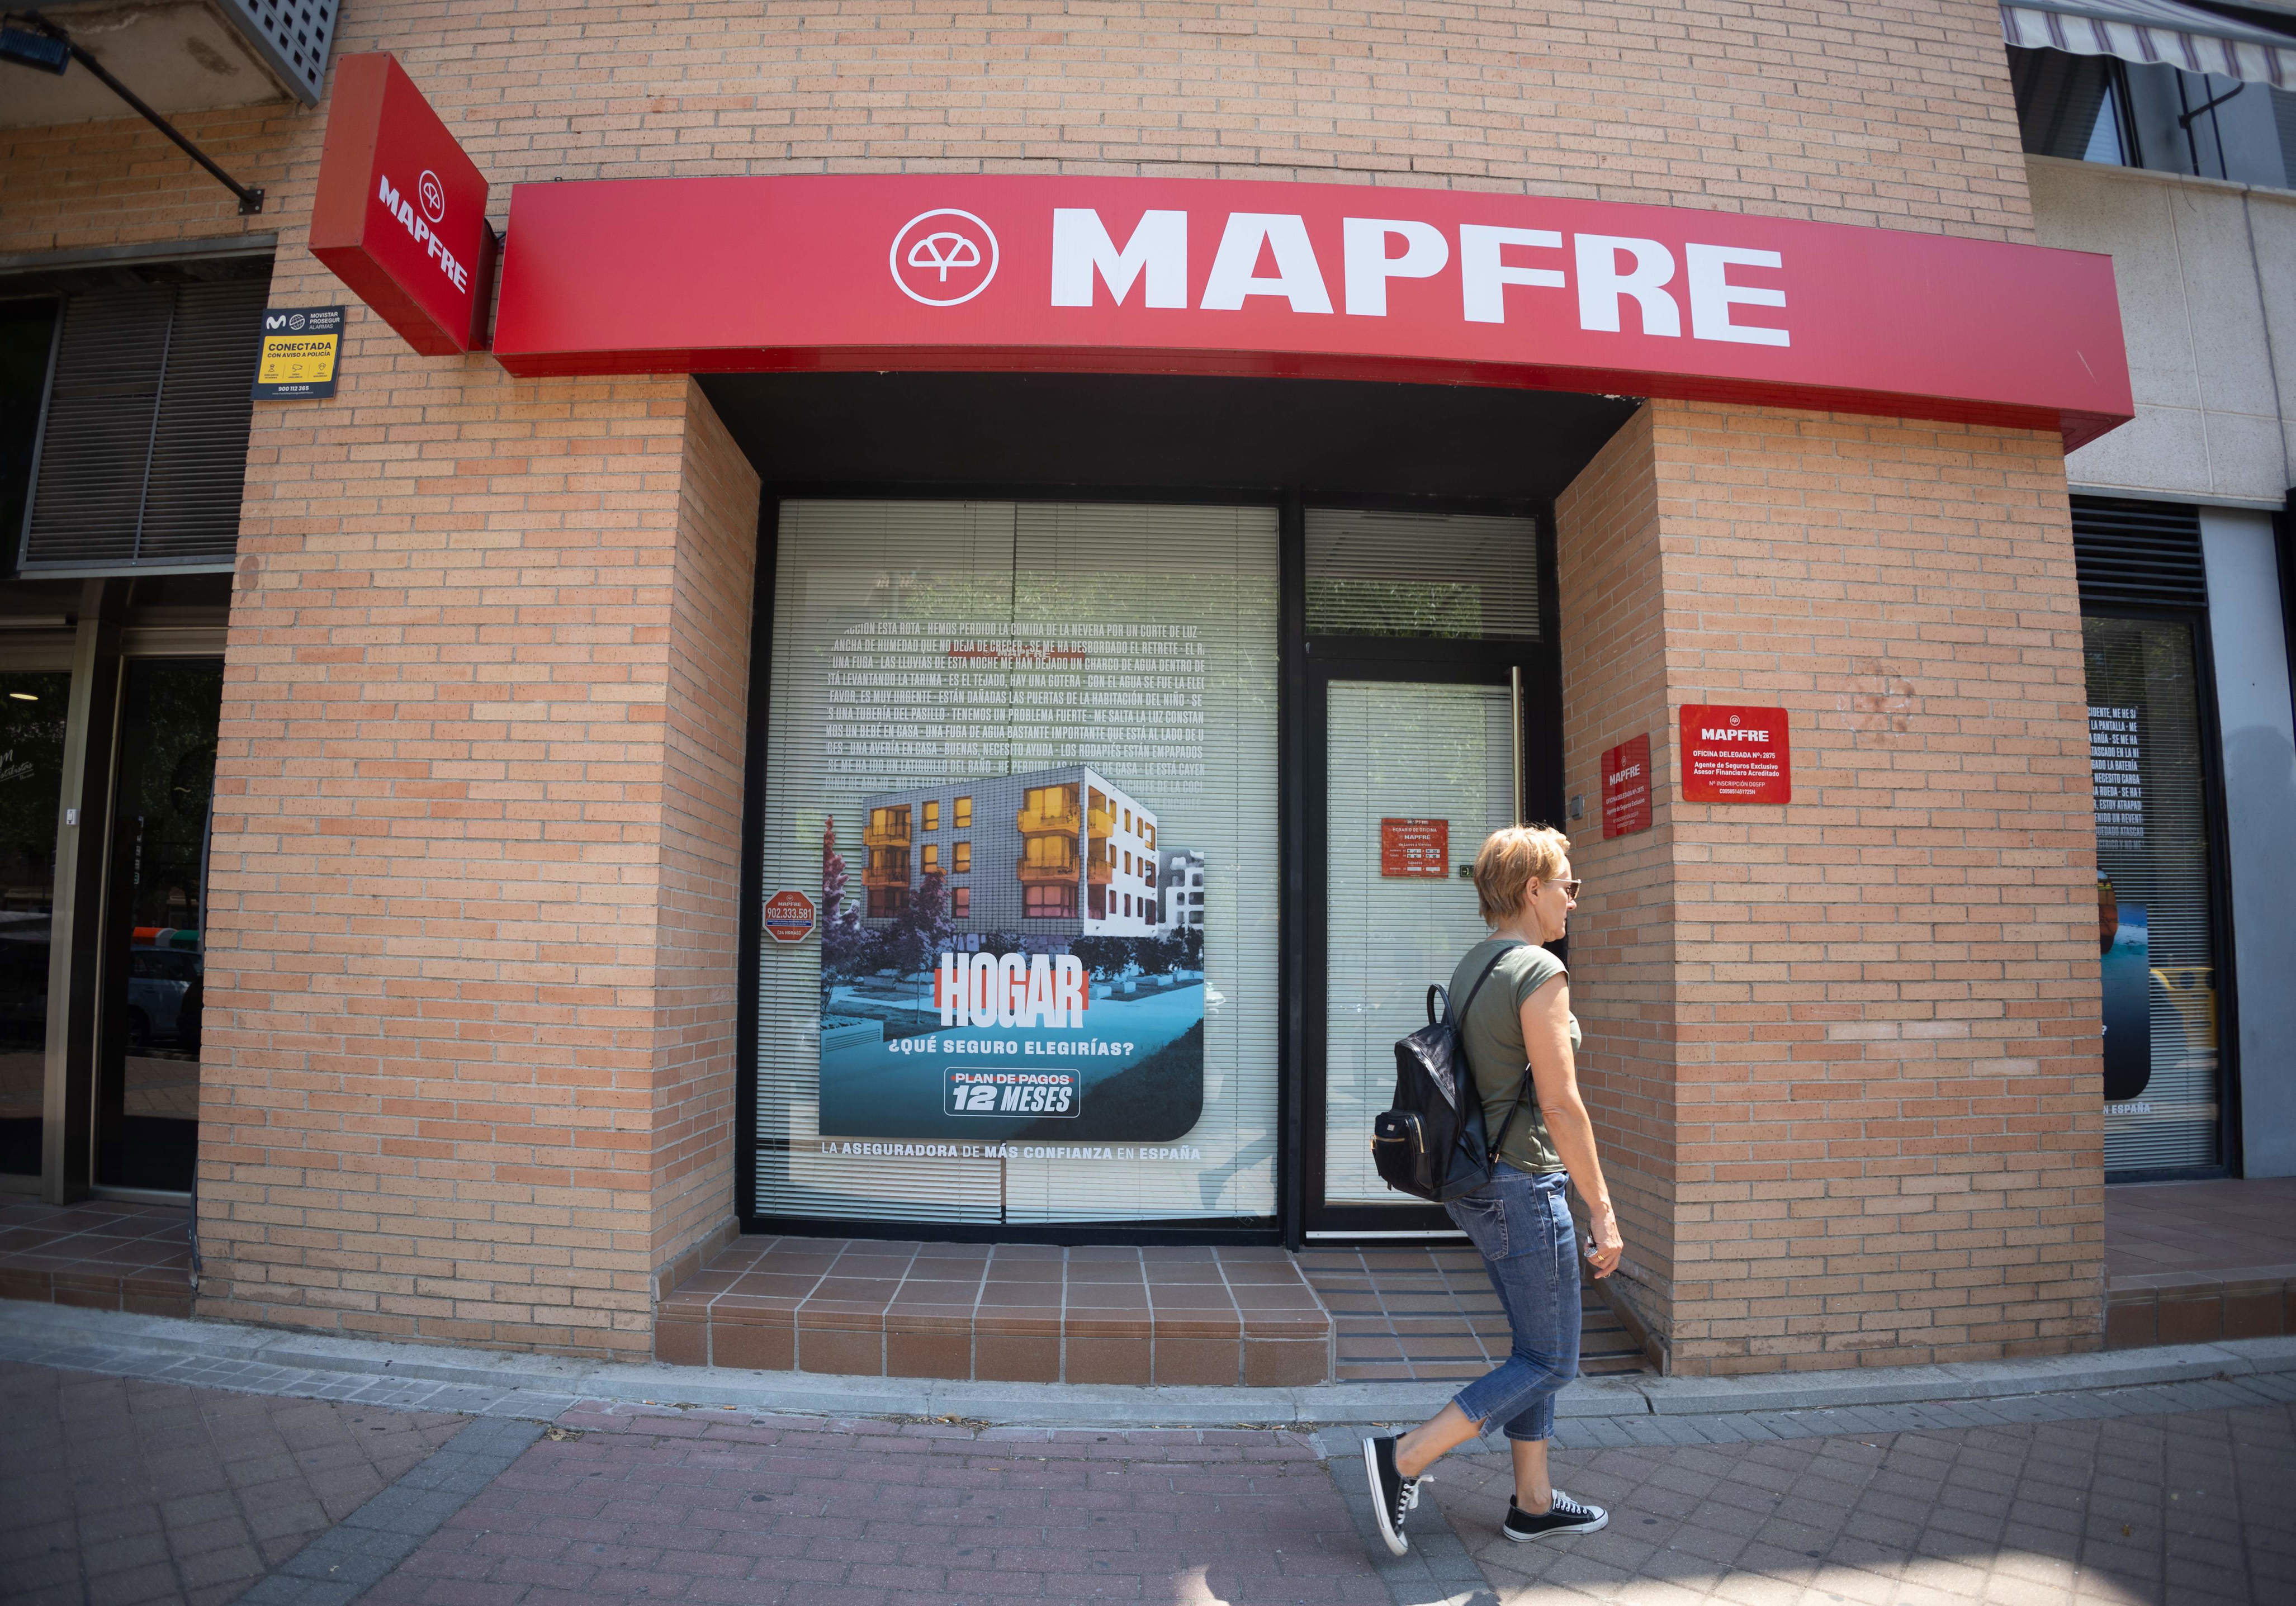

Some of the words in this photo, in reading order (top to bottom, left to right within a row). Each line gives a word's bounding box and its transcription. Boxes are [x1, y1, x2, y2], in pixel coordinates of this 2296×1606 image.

[378, 174, 468, 295] MAPFRE
[1052, 208, 1790, 347] MAPFRE
[268, 342, 332, 351] CONECTADA
[900, 622, 920, 634] ROTA
[927, 622, 956, 635] HEMOS
[959, 623, 996, 635] PERDIDO
[999, 623, 1008, 635] LA
[1011, 623, 1044, 636] COMIDA
[1047, 623, 1057, 636] DE
[1059, 624, 1069, 636] LA
[1072, 624, 1104, 636] NEVERA
[1107, 624, 1123, 637] POR
[1126, 624, 1138, 637] UN
[1140, 624, 1167, 637] CORTE
[1170, 625, 1180, 637] DE
[1182, 625, 1197, 638] LUZ
[831, 639, 862, 651] ANCHA
[865, 639, 875, 651] DE
[878, 639, 919, 652] HUMEDAD
[921, 639, 936, 654] QUE
[940, 639, 950, 652] NO
[954, 639, 974, 652] DEJA
[977, 639, 988, 652] DE
[991, 640, 1022, 652] CRECER
[1030, 640, 1040, 653] SE
[1043, 641, 1055, 653] ME
[1058, 641, 1069, 653] HA
[1071, 641, 1128, 654] DESBORDADO
[1130, 642, 1140, 654] EL
[1142, 642, 1178, 655] RETRETE
[1185, 642, 1195, 655] EL
[832, 656, 850, 669] UNA
[853, 656, 873, 669] FUGA
[880, 656, 896, 669] LAS
[898, 656, 932, 669] LLUVIAS
[935, 656, 945, 669] DE
[948, 656, 967, 669] ESTA
[970, 656, 998, 669] NOCHE
[1001, 657, 1013, 670] ME
[1015, 657, 1033, 670] HAN
[1035, 657, 1068, 670] DEJADO
[1071, 657, 1082, 670] UN
[1085, 658, 1119, 671] CHARCO
[1121, 658, 1132, 671] DE
[1134, 658, 1157, 671] AGUA
[1159, 658, 1191, 672] DENTRO
[1195, 659, 1205, 672] DE
[842, 674, 895, 686] LEVANTANDO
[898, 674, 908, 686] LA
[910, 674, 942, 686] TARIMA
[949, 674, 959, 686] ES
[962, 674, 971, 686] EL
[973, 674, 1007, 688] TEJADO,
[1010, 674, 1026, 687] HAY
[1029, 674, 1046, 687] UNA
[1048, 675, 1081, 688] GOTERA
[1088, 675, 1105, 688] CON
[1107, 675, 1118, 688] EL
[1120, 675, 1142, 688] AGUA
[1144, 676, 1154, 689] SE
[1157, 676, 1172, 689] FUE
[1175, 676, 1185, 689] LA
[830, 690, 858, 704] FAVOR,
[861, 690, 871, 703] ES
[873, 690, 891, 703] MUY
[894, 690, 932, 703] URGENTE
[939, 688, 964, 703] ESTÁN
[967, 688, 1006, 703] DAÑADAS
[1009, 691, 1024, 704] LAS
[1027, 691, 1064, 704] PUERTAS
[1067, 691, 1077, 704] DE
[1080, 691, 1090, 704] LA
[1092, 689, 1143, 705] HABITACIÓN
[1145, 693, 1161, 705] DEL
[1163, 690, 1185, 706] NIÑO
[1191, 693, 1202, 706] SE
[2113, 708, 2122, 718] ME
[2122, 709, 2129, 719] HE
[2091, 720, 2098, 731] LA
[2099, 721, 2125, 731] PANTALLA
[2129, 722, 2137, 732] ME
[1701, 728, 1769, 742] MAPFRE
[2093, 732, 2109, 743] GRÚA
[2112, 734, 2120, 745] SE
[2120, 735, 2129, 745] ME
[2129, 735, 2138, 745] HA
[2117, 747, 2124, 757] EN
[2125, 747, 2132, 757] LA
[2107, 760, 2114, 770] LA
[2115, 759, 2138, 771] BATERÍA
[1609, 764, 1641, 786] MAPFRE
[2094, 773, 2120, 783] NECESITO
[2122, 774, 2140, 784] CARGA
[2100, 786, 2118, 797] RUEDA
[2122, 787, 2129, 797] SE
[2130, 788, 2138, 797] HA
[2099, 799, 2116, 809] ESTOY
[767, 908, 812, 919] 902.333.581
[940, 952, 1083, 1029] HOGAR
[888, 1035, 936, 1054] ¿QUÉ
[943, 1039, 1017, 1055] SEGURO
[1024, 1038, 1134, 1056] ELEGIRÍAS?
[955, 1073, 993, 1084] PLAN
[997, 1074, 1015, 1084] DE
[1018, 1074, 1070, 1085] PAGOS
[953, 1085, 996, 1111] 12
[1000, 1086, 1072, 1112] MESES
[2112, 1102, 2151, 1114] ESPAÑA
[821, 1142, 838, 1154] LA
[842, 1143, 958, 1158] ASEGURADORA
[962, 1145, 980, 1158] DE
[984, 1142, 1019, 1158] MÁS
[1023, 1146, 1113, 1160] CONFIANZA
[1117, 1148, 1135, 1160] EN
[1139, 1145, 1200, 1160] ESPAÑA
